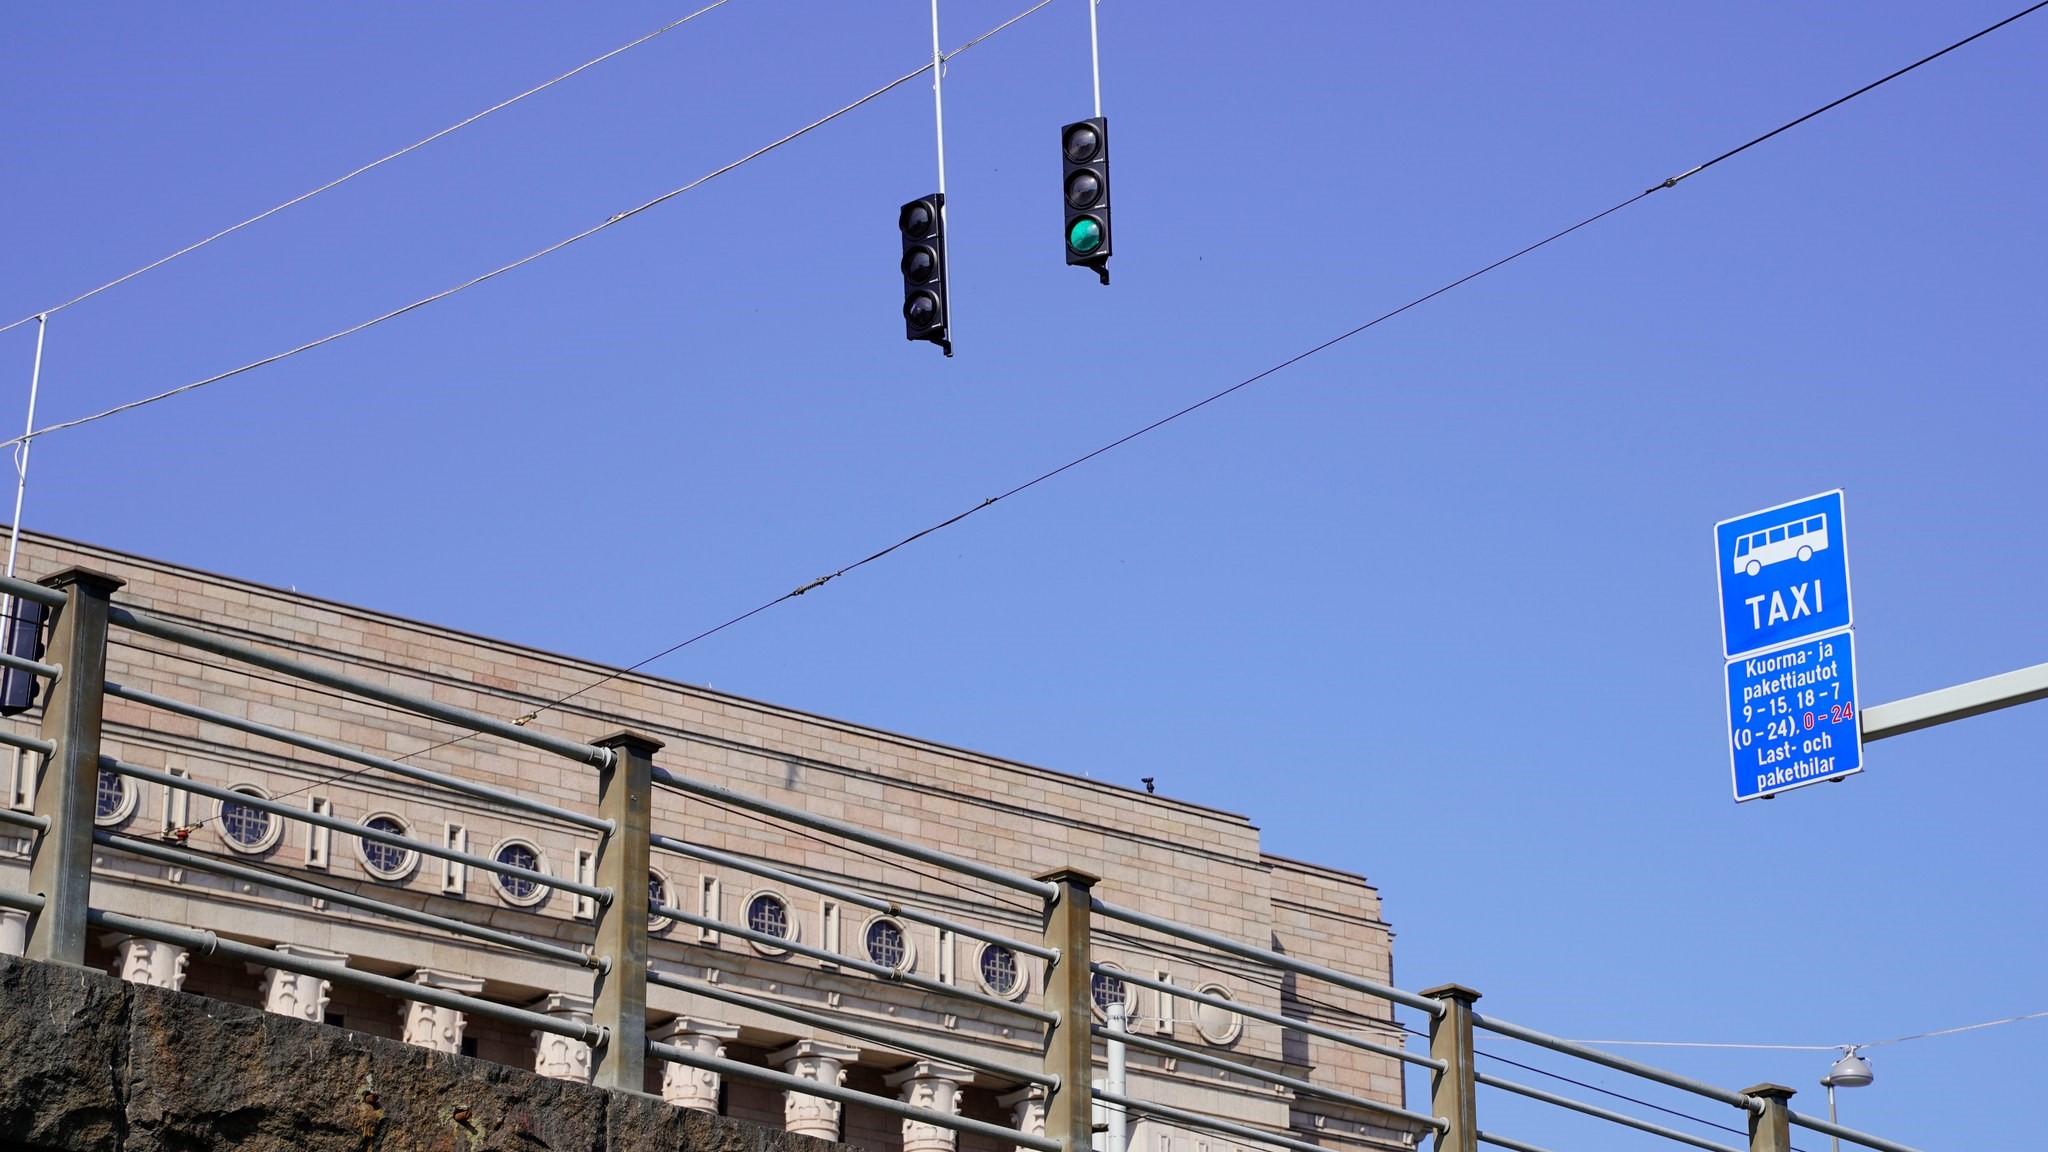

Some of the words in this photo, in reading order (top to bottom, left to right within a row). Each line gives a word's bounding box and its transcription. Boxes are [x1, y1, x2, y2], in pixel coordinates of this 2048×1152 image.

[1745, 579, 1823, 630] TAXI
[1746, 649, 1813, 678] Kuorma-
[1818, 641, 1833, 662] ja
[1743, 660, 1838, 703] pakettiautot
[1757, 741, 1797, 766] Last-
[1803, 731, 1832, 754] och
[1757, 756, 1835, 792] paketbilar
